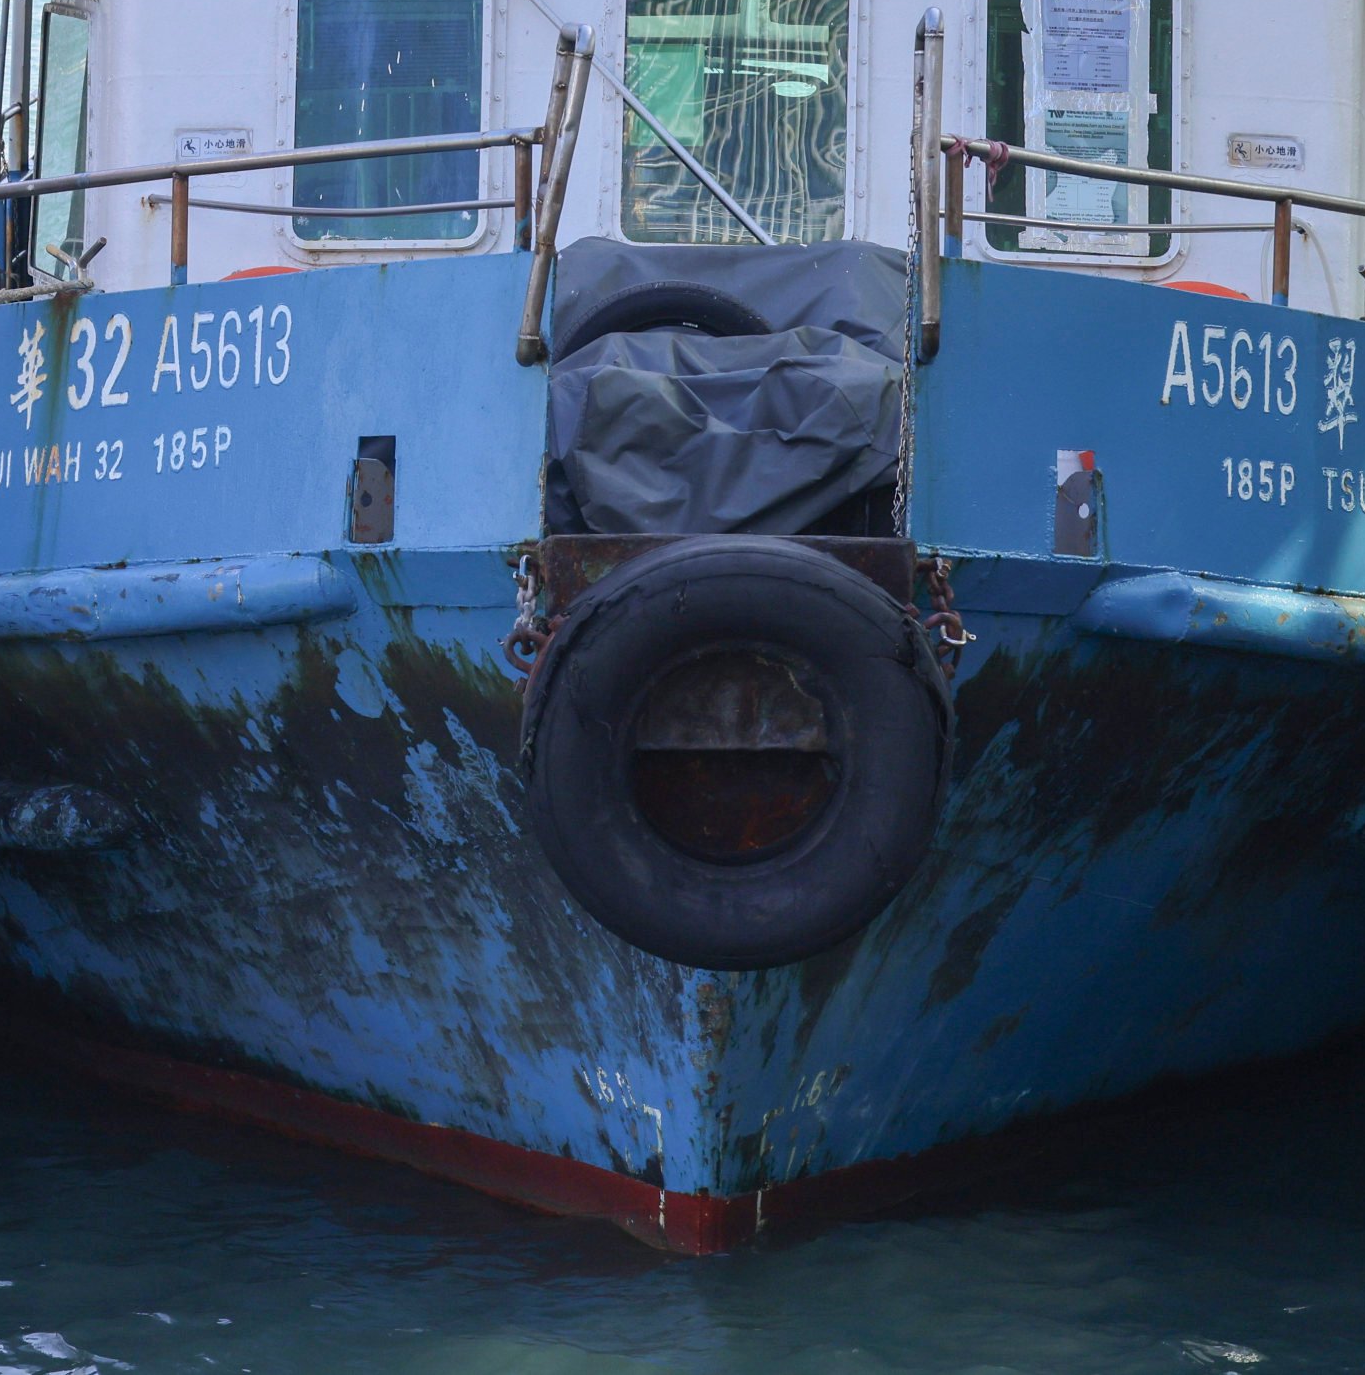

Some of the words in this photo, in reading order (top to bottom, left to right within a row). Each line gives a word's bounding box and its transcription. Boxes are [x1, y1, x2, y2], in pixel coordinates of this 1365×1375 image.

[204, 138, 246, 148] 小心地滑
[1255, 144, 1296, 156] 小心地滑
[67, 313, 132, 410] 32
[151, 304, 292, 393] A5613
[1160, 320, 1297, 415] A5613
[24, 442, 82, 486] WAH
[94, 439, 124, 481] 32
[153, 425, 232, 474] 185P
[1221, 457, 1295, 506] 185P
